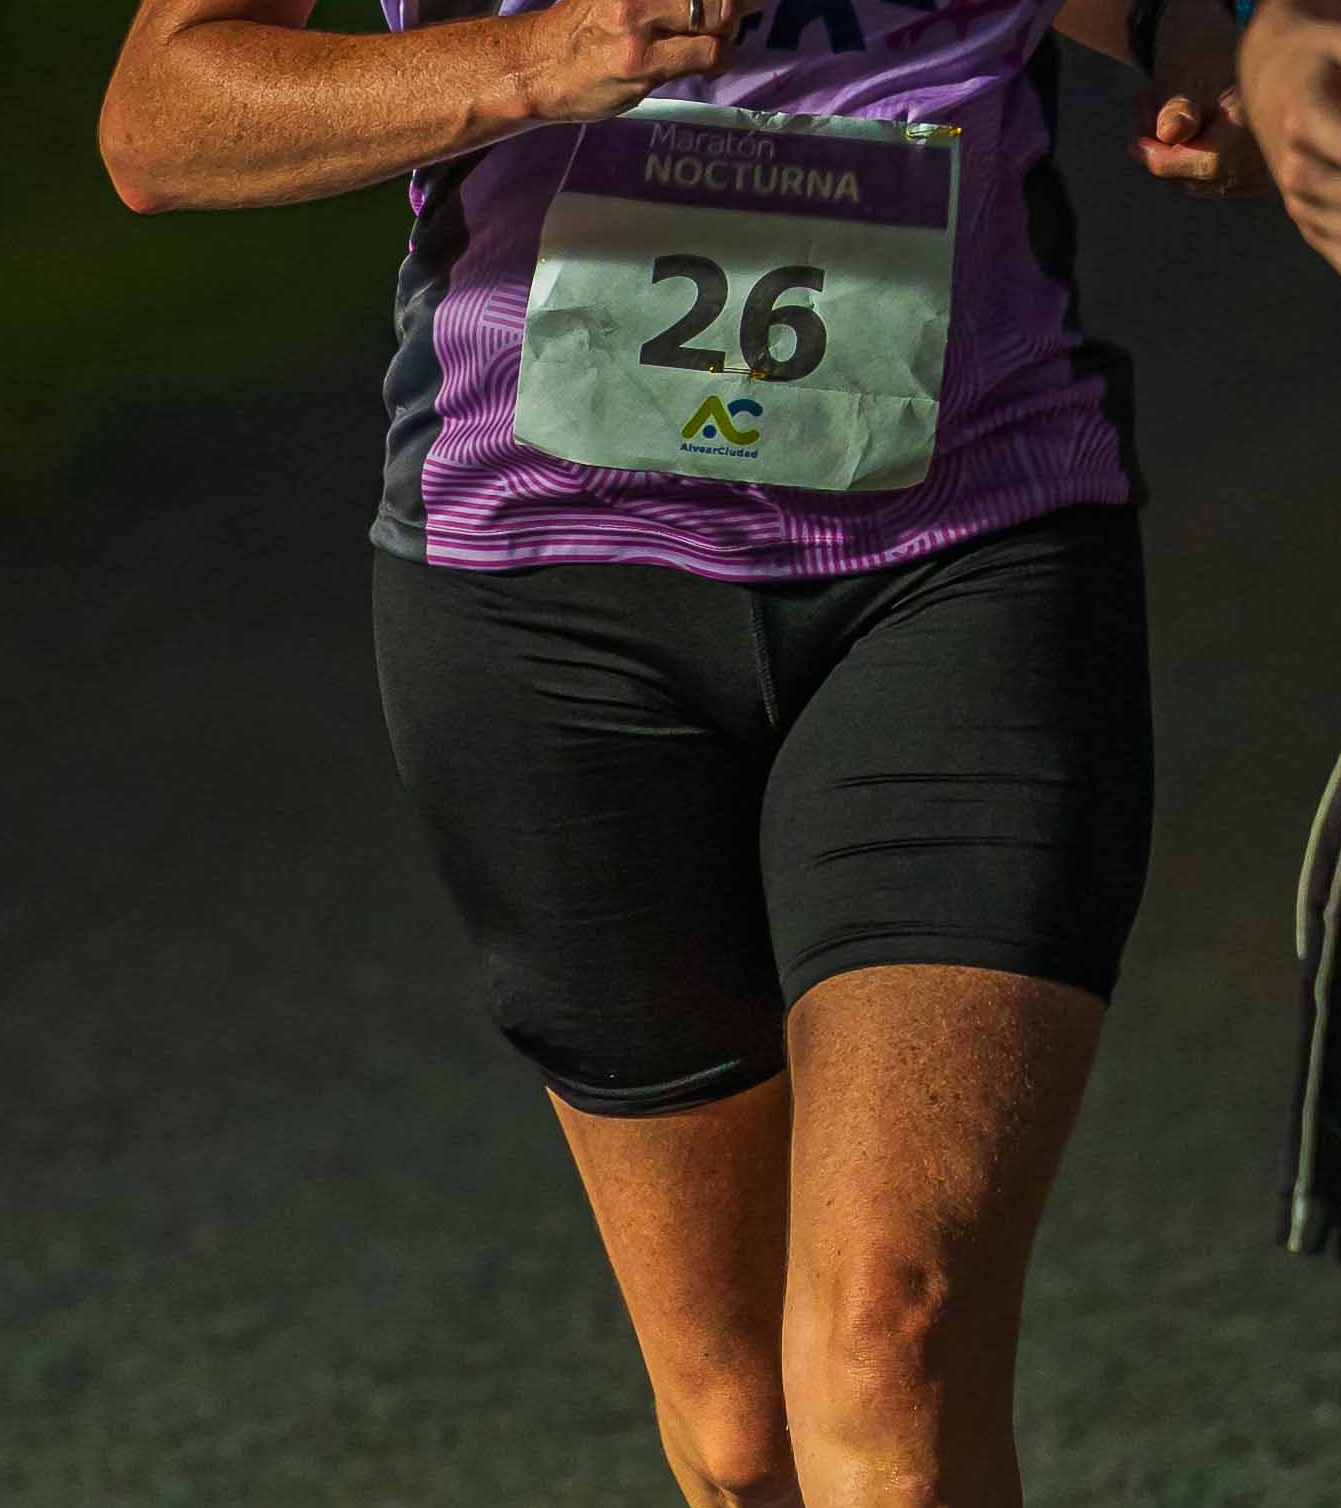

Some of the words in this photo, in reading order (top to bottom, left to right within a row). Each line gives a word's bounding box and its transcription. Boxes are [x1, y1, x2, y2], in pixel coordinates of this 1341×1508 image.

[646, 121, 777, 161] Maratón
[643, 152, 860, 205] NOCTURNA
[638, 252, 828, 382] 26
[679, 443, 759, 459] AlvearCiudad
